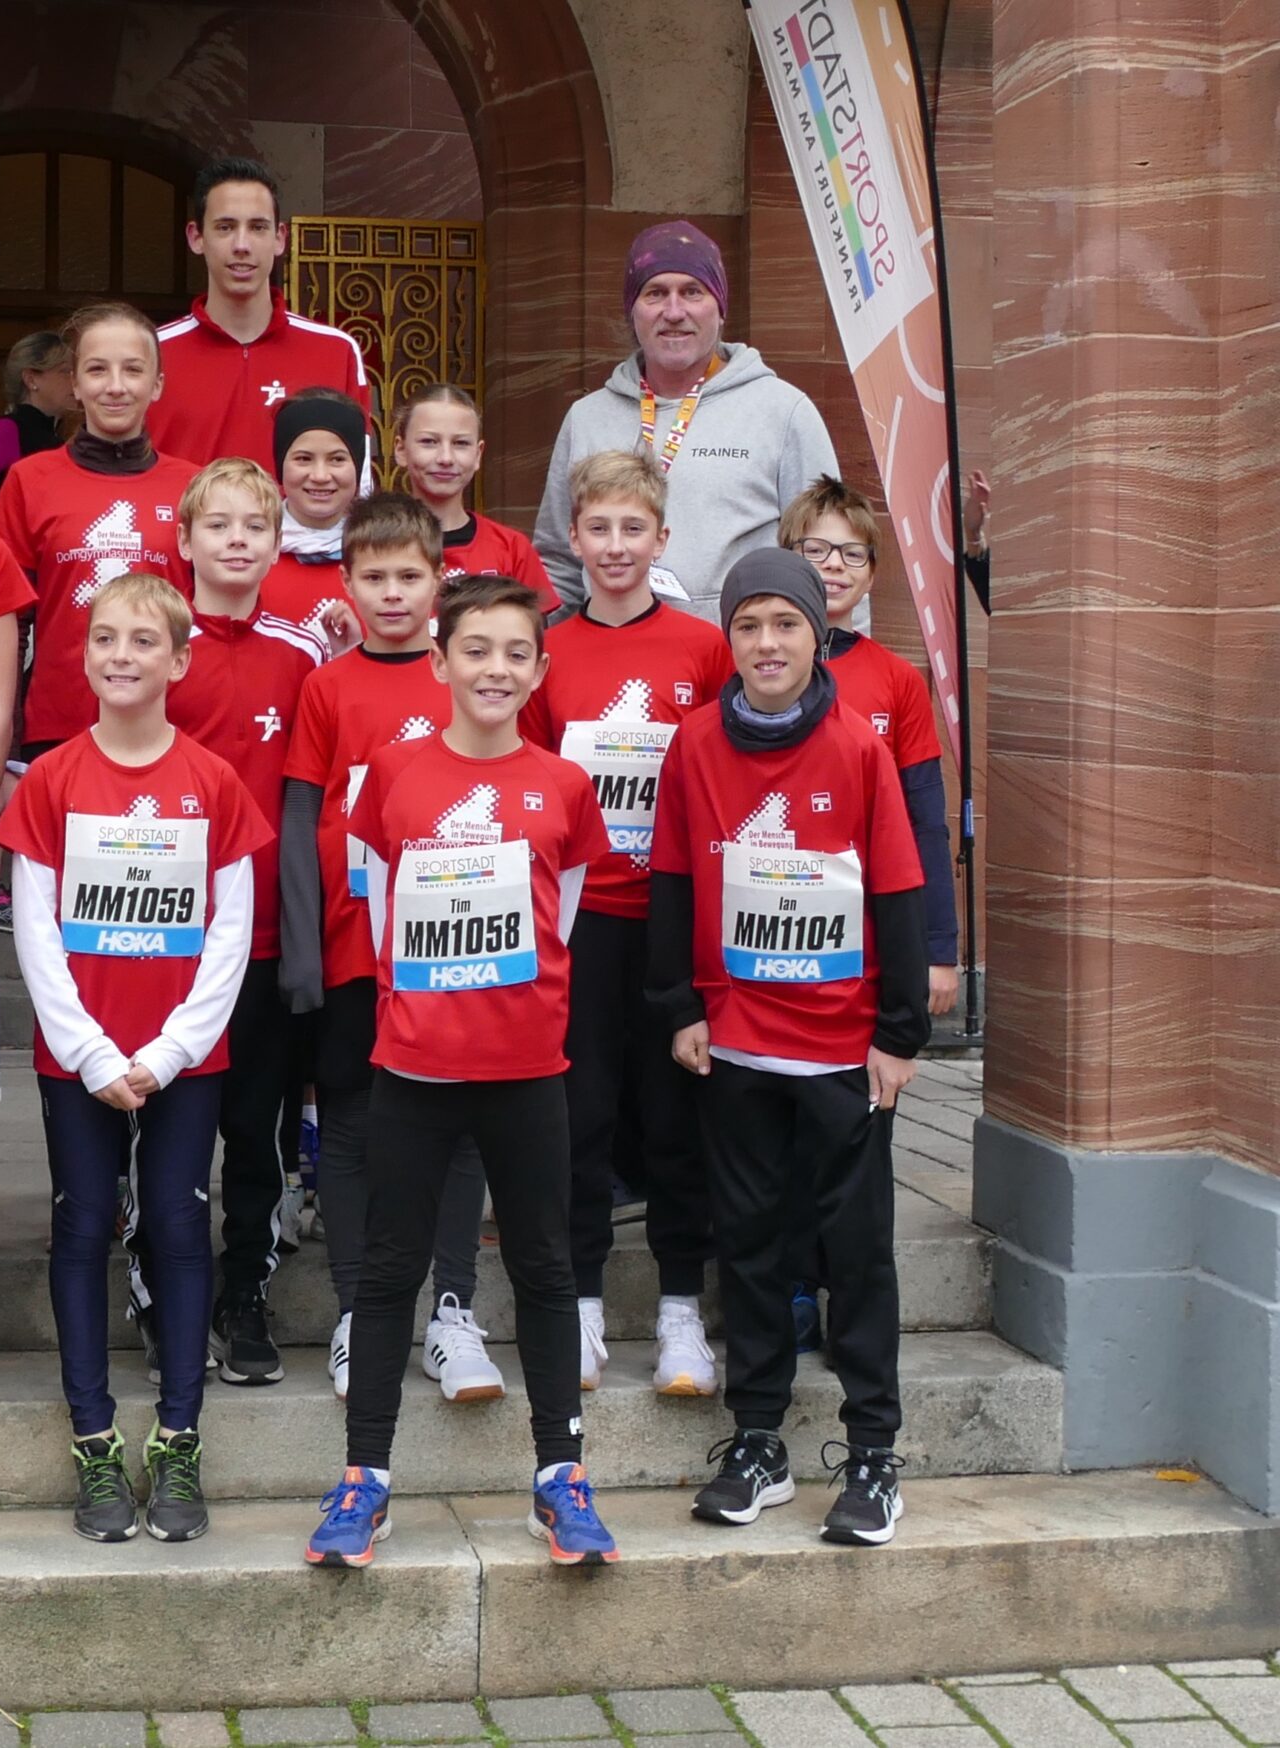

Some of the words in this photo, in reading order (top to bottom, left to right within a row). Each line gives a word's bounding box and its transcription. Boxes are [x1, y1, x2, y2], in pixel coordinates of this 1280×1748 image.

[691, 447, 749, 459] TRAINER
[97, 531, 108, 539] Der
[110, 531, 132, 539] Mensch
[99, 539, 106, 547] in
[107, 539, 139, 549] Bewegung
[56, 549, 141, 564] Domgymnasium
[144, 550, 168, 566] Fulda
[594, 731, 669, 746] SPORTSTADT
[98, 826, 180, 842] SPORTSTADT
[450, 820, 463, 829] Der
[465, 820, 492, 832] Mensch
[451, 830, 459, 839] in
[460, 830, 499, 842] Bewegung
[749, 830, 760, 839] Der
[762, 830, 786, 839] Mensch
[750, 840, 757, 848] in
[759, 840, 794, 850] Bewegung
[415, 855, 496, 875] SPORTSTADT
[749, 857, 825, 873] SPORTSTADT
[126, 866, 152, 882] Max
[72, 883, 195, 924] MM1059
[450, 898, 471, 914] Tim
[779, 897, 797, 911] Ian
[403, 911, 521, 958] MM1058
[733, 911, 846, 951] MM1104
[97, 930, 167, 953] HOKA
[429, 962, 500, 988] HOKA
[753, 958, 820, 979] HOKA
